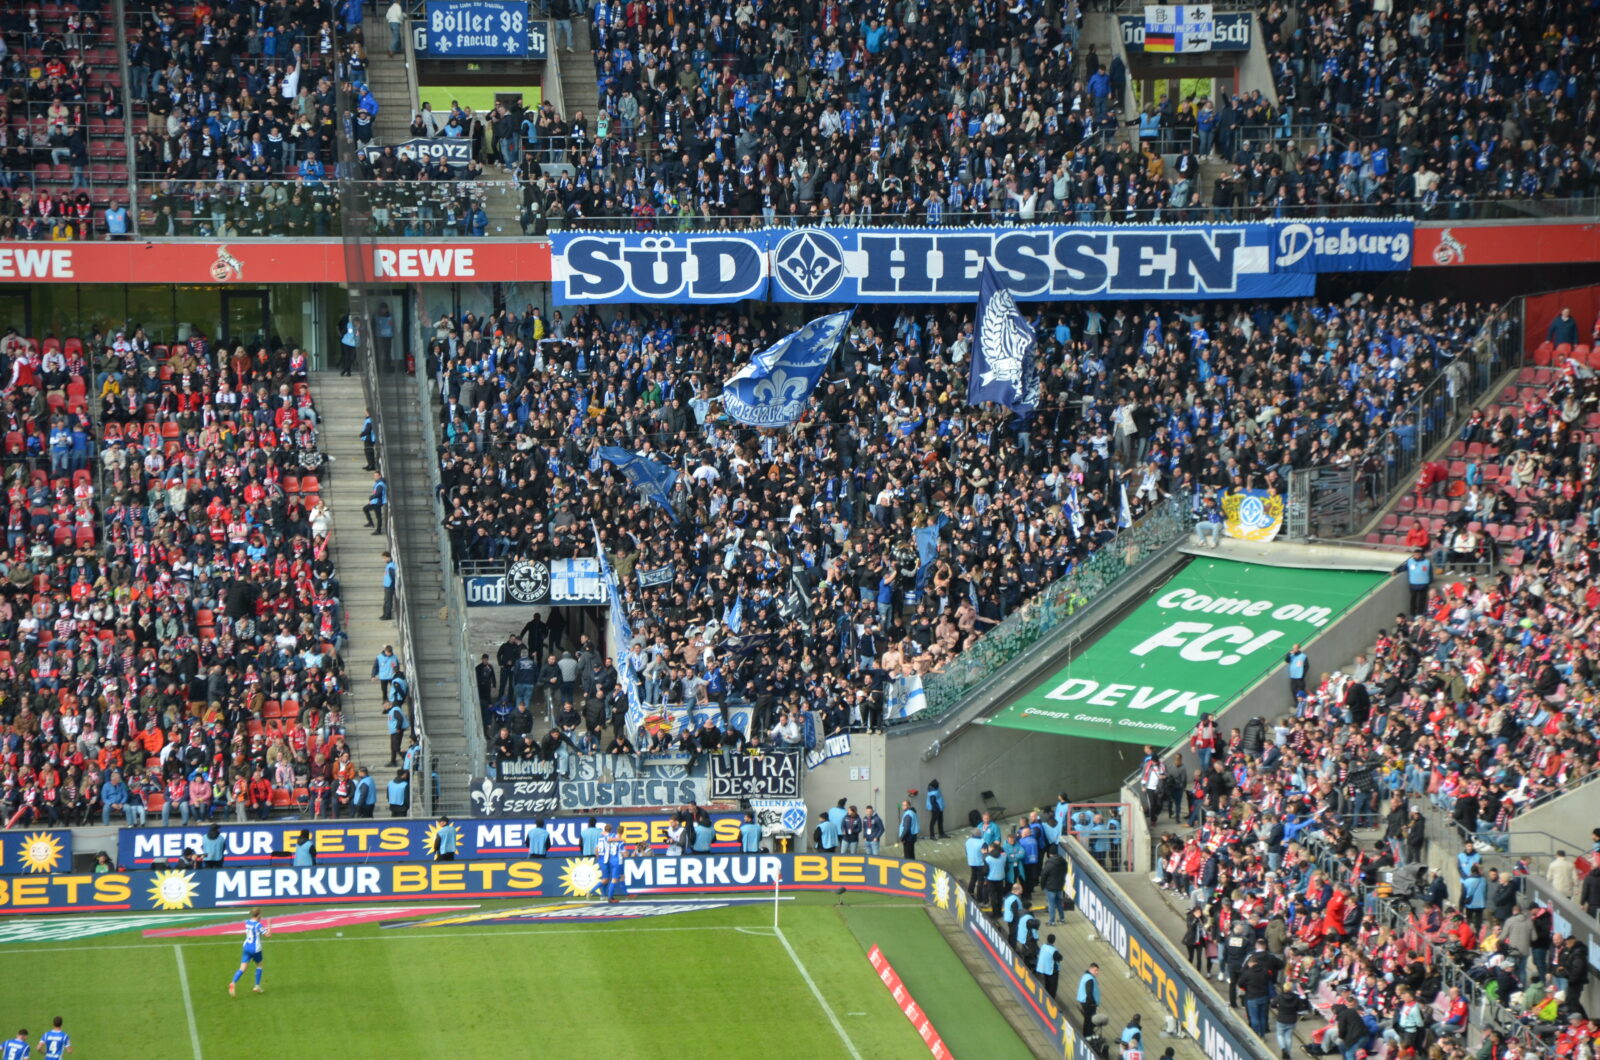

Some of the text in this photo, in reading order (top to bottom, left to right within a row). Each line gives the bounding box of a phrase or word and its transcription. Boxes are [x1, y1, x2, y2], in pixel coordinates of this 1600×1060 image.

[432, 9, 523, 33] Böller 98
[418, 143, 469, 159] BOYZ
[1275, 222, 1411, 268] Dieburg
[373, 248, 475, 277] REWE
[565, 229, 1246, 299] SÜD HESSEN
[1156, 587, 1334, 628] Come on,
[1129, 620, 1286, 666] FC!
[1043, 677, 1221, 717] DEVK
[1022, 705, 1071, 722] Gesagt.
[1117, 716, 1179, 733] Geholfen.
[711, 754, 796, 778] ULTRA
[513, 780, 554, 796] ROW
[561, 778, 697, 809] SUSPECTS
[713, 777, 796, 795] DE LIS
[502, 797, 558, 813] SEVEN
[134, 830, 274, 858] MERUR
[619, 818, 743, 843] BES
[215, 861, 544, 899] MERKUR BETS
[624, 854, 927, 891] MERKUR BETS
[0, 873, 132, 907] ETS
